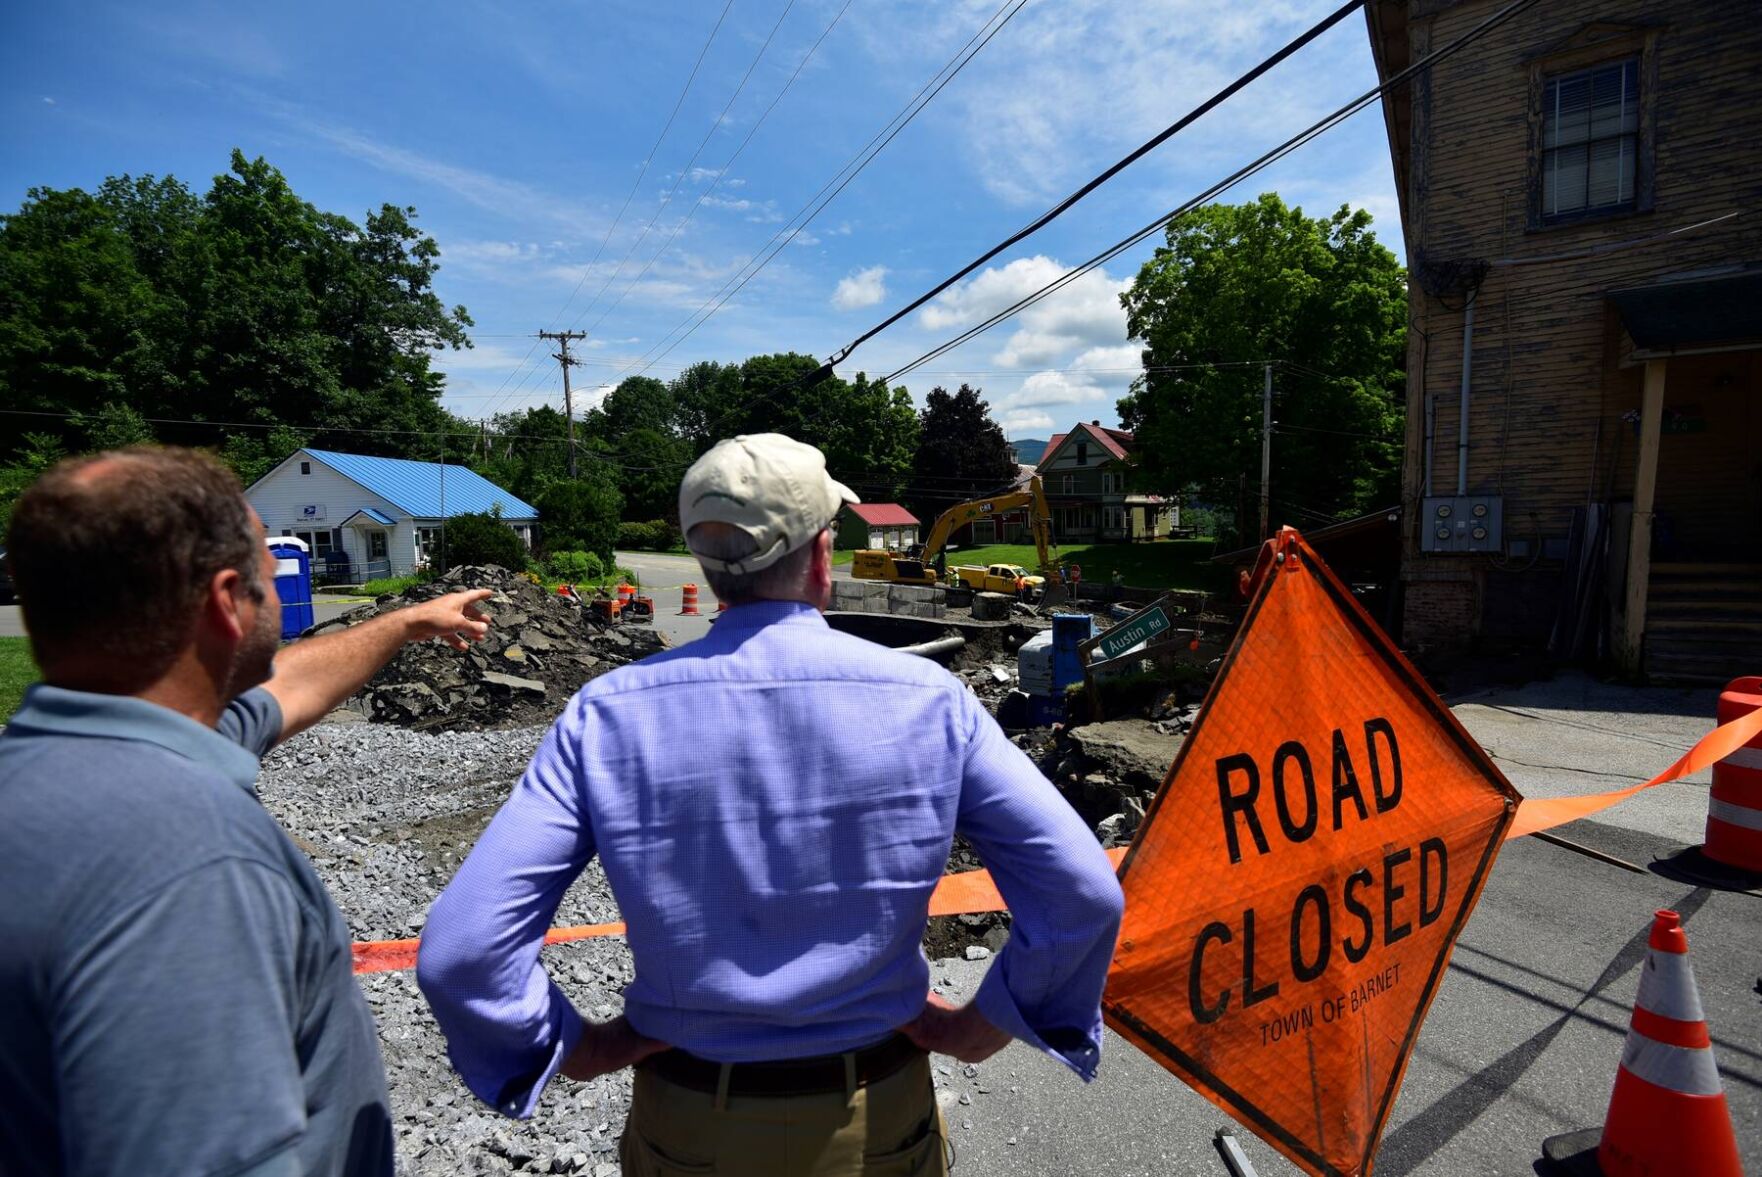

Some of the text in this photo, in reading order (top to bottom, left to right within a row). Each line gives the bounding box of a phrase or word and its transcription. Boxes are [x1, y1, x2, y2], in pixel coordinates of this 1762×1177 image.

[1109, 618, 1161, 653] Austin Rd
[1215, 717, 1404, 864] ROAD
[1187, 836, 1448, 1025] CLOSED
[1259, 963, 1401, 1047] TOWN OF BARNET
